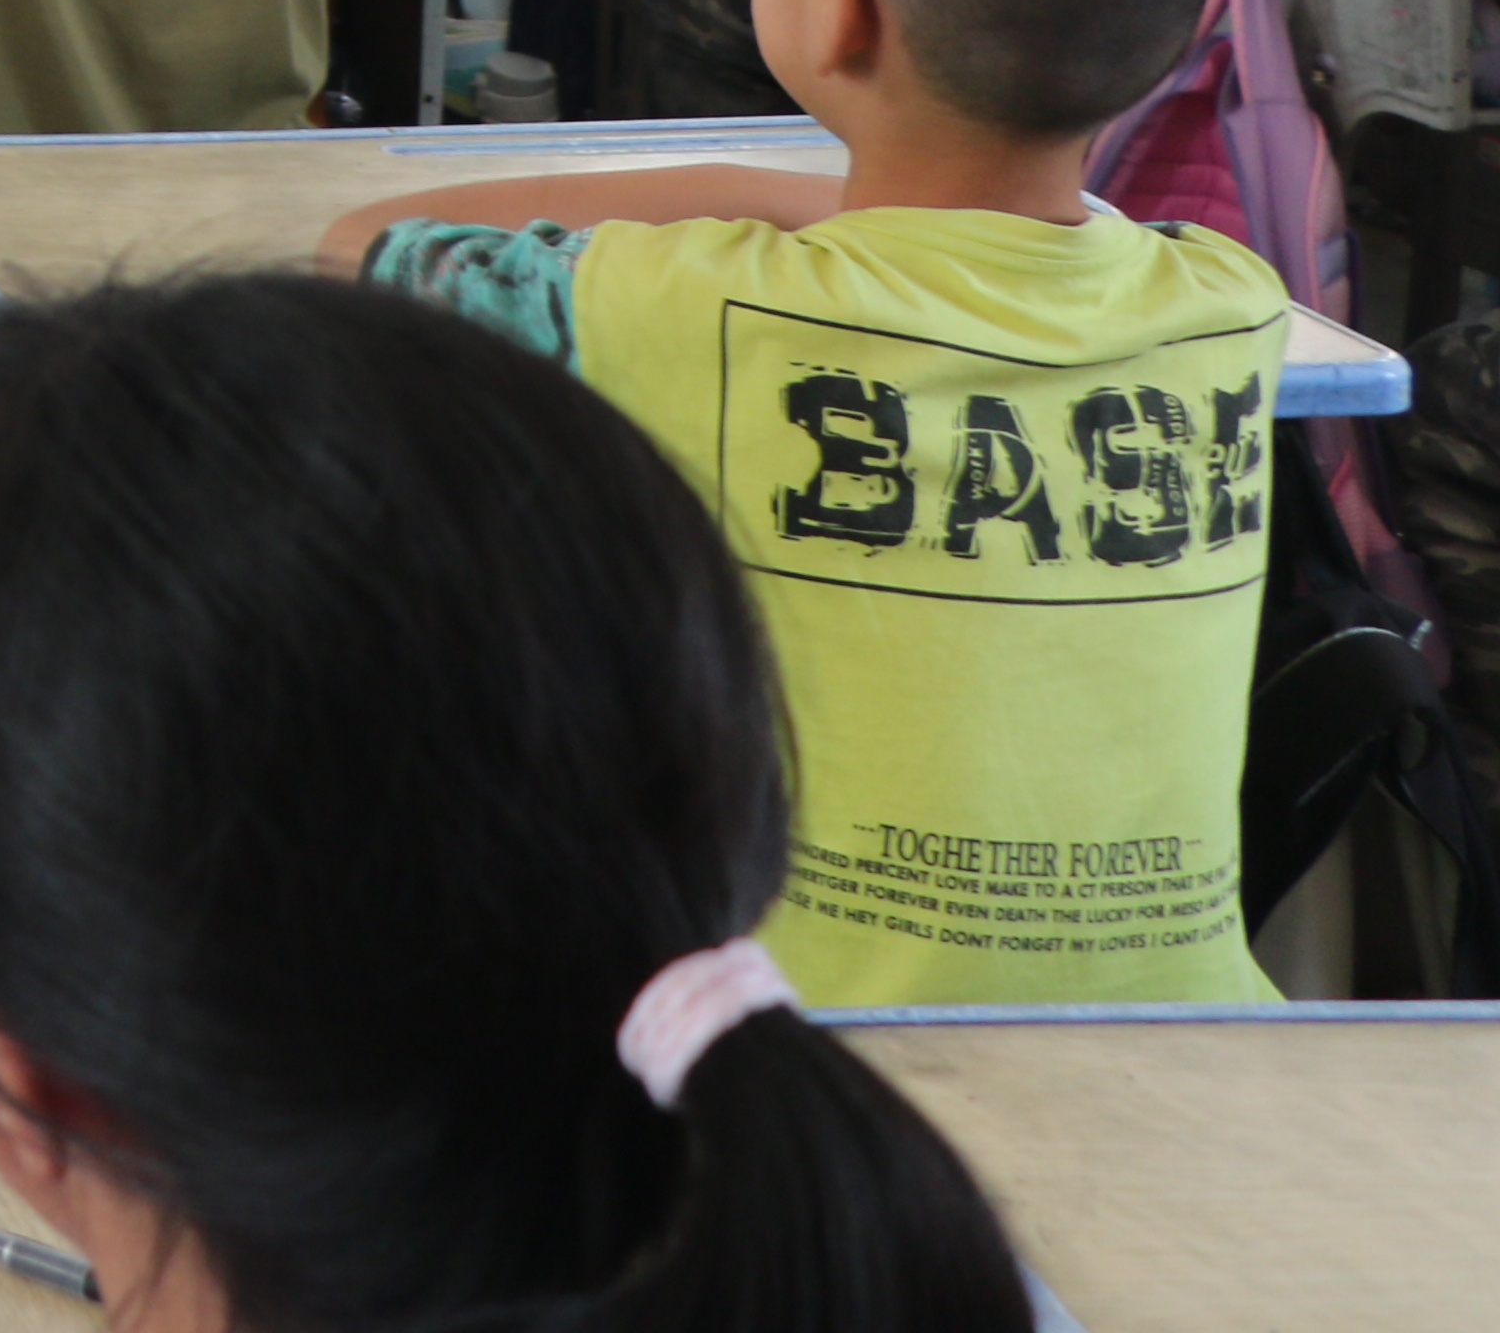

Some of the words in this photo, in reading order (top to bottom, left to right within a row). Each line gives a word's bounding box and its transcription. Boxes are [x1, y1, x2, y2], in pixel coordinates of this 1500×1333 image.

[856, 858, 929, 884] PERCENT
[935, 874, 980, 894] LOVE
[986, 881, 1028, 897] MAKE
[1035, 883, 1055, 898] TO
[1061, 883, 1073, 899] A
[1101, 880, 1157, 898] PERSON
[864, 883, 938, 912] FOREVER
[945, 900, 989, 919] EVEN
[994, 906, 1046, 922] DEATH
[1052, 908, 1080, 923] THE
[1086, 907, 1132, 923] LUCKY
[1136, 904, 1164, 918] FOR
[816, 900, 839, 918] ME
[845, 907, 879, 927] HEY
[885, 916, 933, 939] GIRLS
[939, 928, 994, 949] DONT
[999, 935, 1065, 952] FORGET
[1069, 937, 1094, 952] MY
[1100, 933, 1146, 951] LOVES
[1161, 929, 1199, 947] CANT
